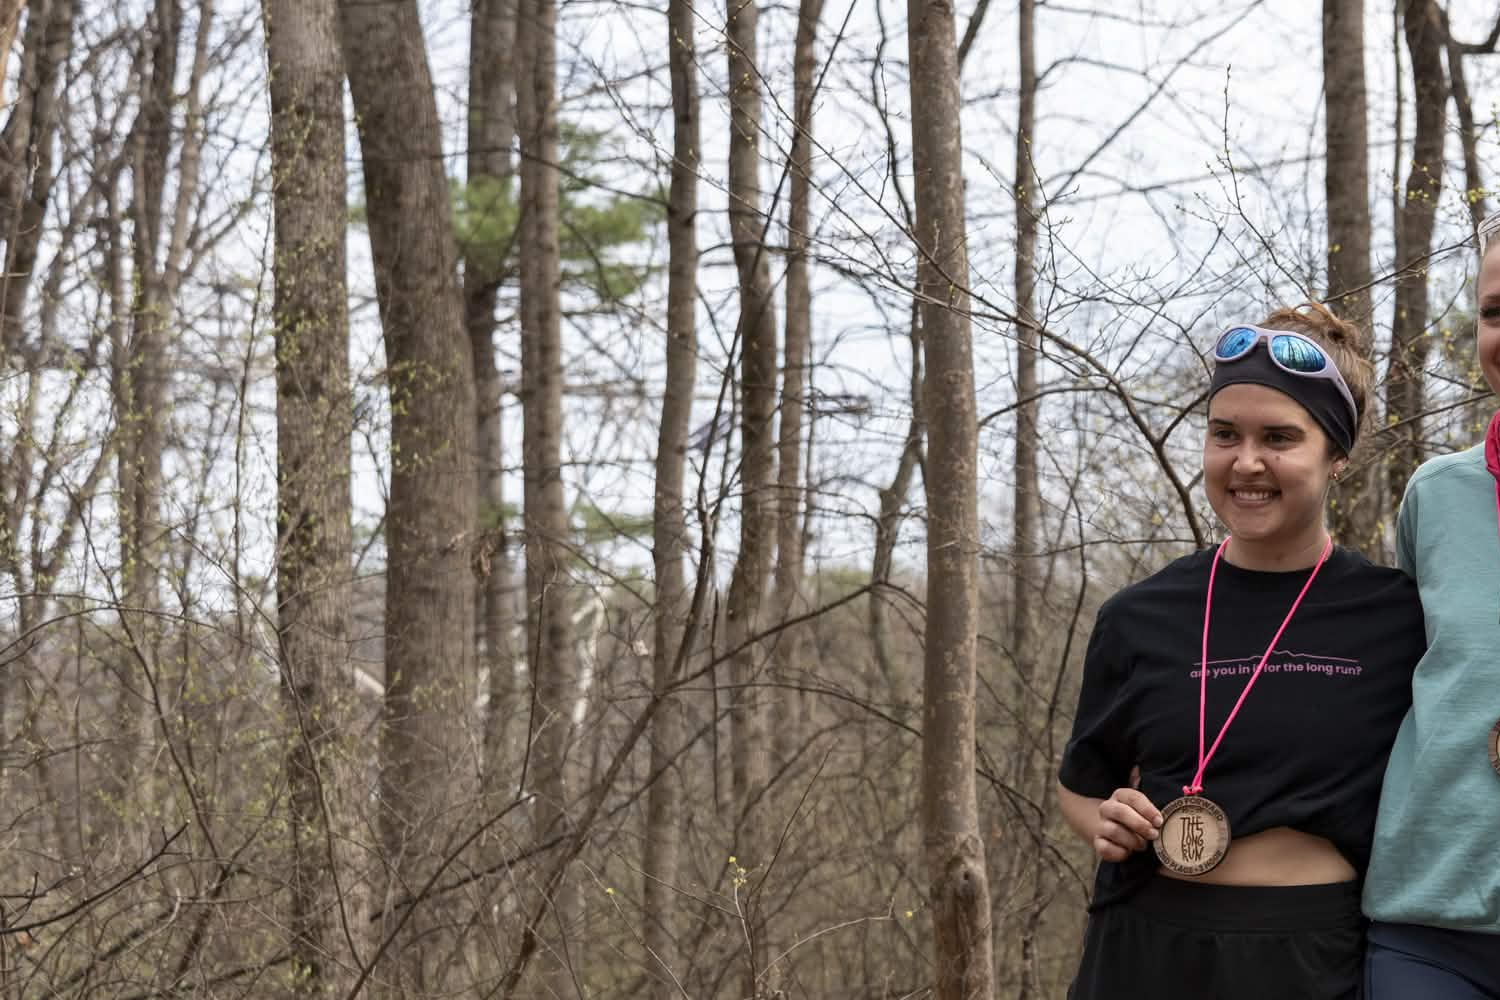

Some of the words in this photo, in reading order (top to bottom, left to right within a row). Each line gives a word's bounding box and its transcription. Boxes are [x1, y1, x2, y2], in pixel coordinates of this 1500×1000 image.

[1213, 667, 1236, 679] you
[1238, 664, 1250, 674] in
[1264, 663, 1281, 673] for
[1283, 662, 1304, 672] the
[1306, 662, 1333, 675] long
[1335, 665, 1362, 676] run?
[1181, 846, 1205, 862] RUN
